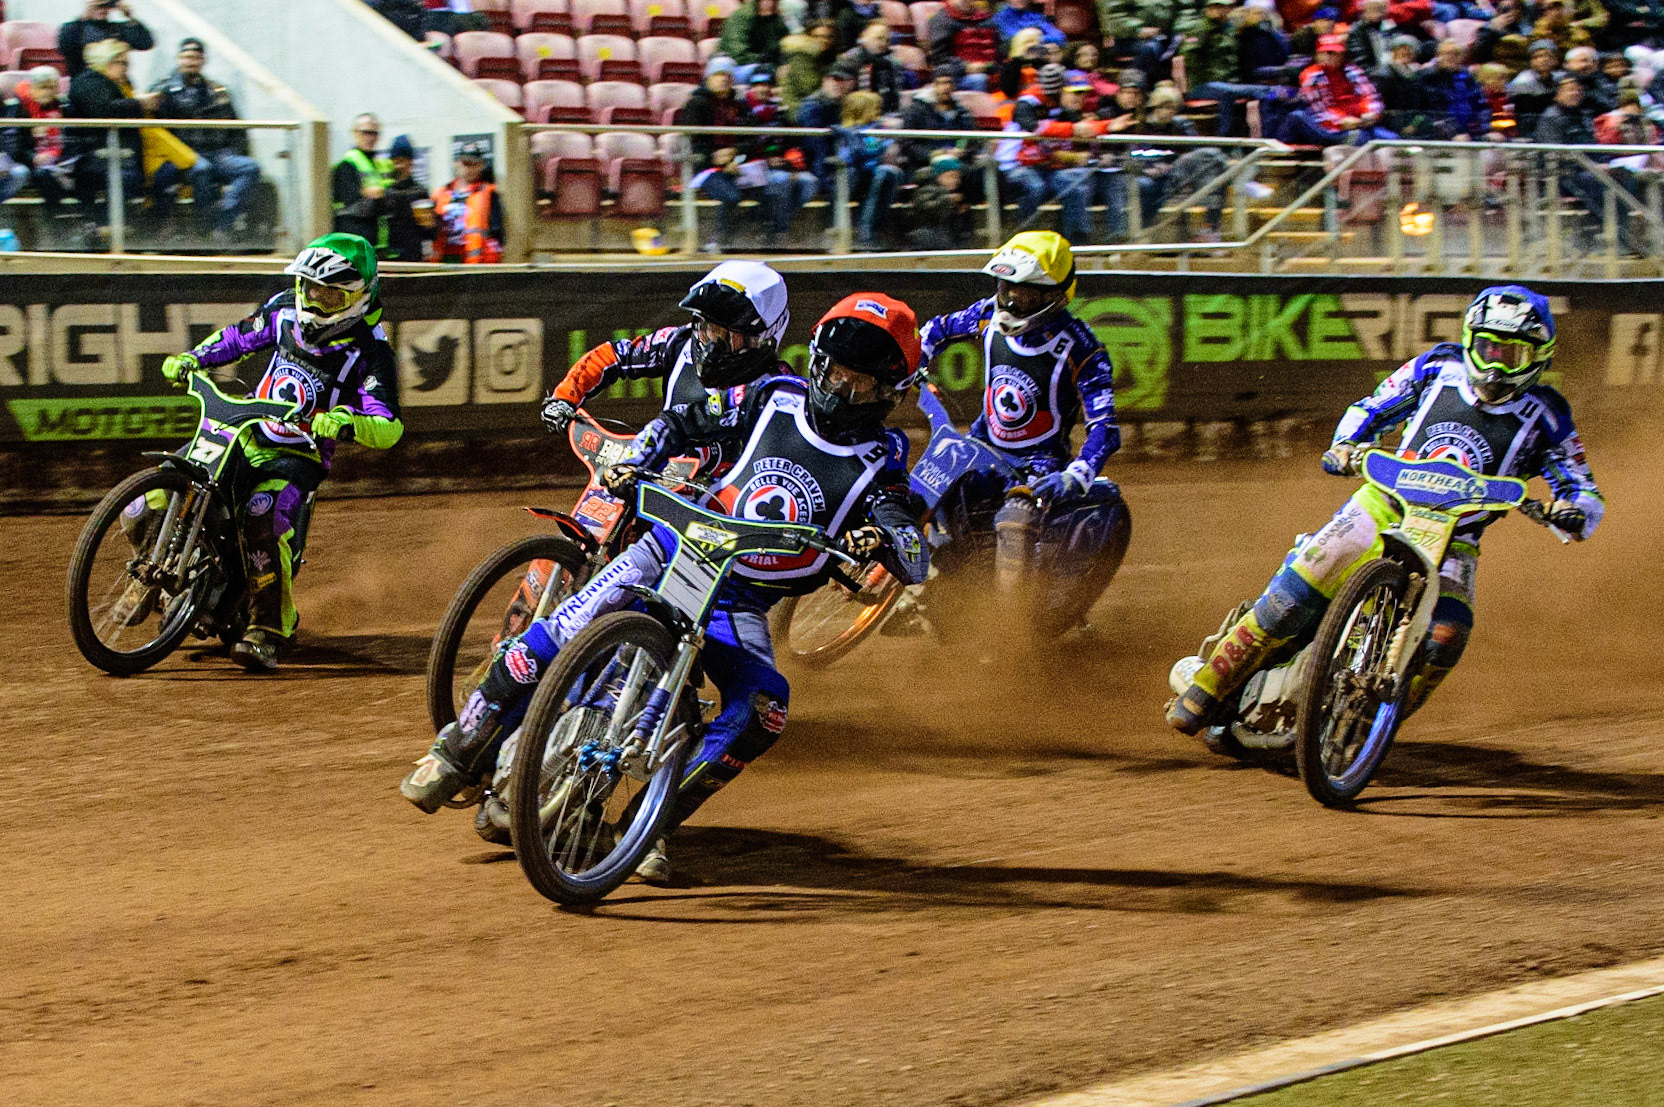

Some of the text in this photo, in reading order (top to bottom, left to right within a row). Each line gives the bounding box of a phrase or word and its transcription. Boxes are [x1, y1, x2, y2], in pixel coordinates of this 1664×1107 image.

[753, 457, 827, 513] PETER CRAVEN
[919, 459, 954, 487] ADRIAN
[919, 468, 942, 490] FLUX
[749, 475, 809, 523] BELLE VUE ACES
